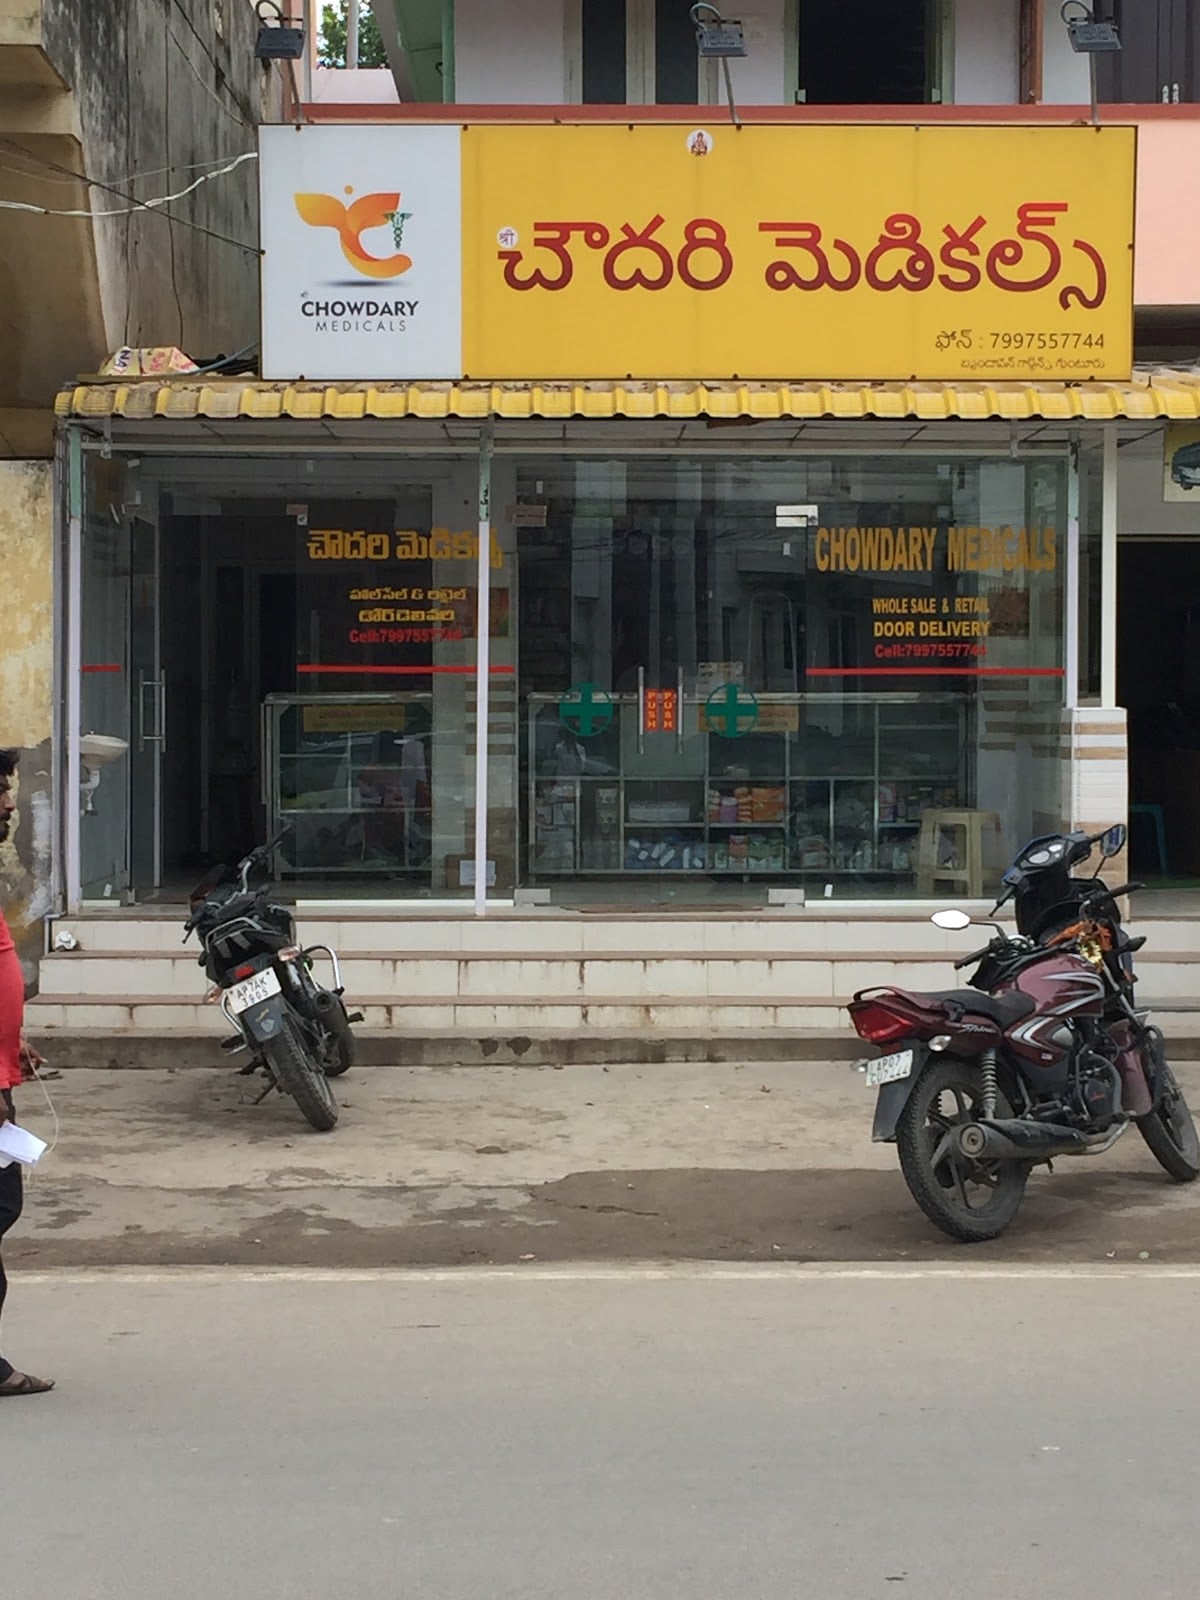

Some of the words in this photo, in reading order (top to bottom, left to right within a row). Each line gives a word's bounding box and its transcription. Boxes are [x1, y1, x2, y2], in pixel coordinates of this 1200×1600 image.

[497, 214, 734, 291] చౌదరి
[758, 203, 1107, 311] మెడికల్స్
[301, 300, 419, 317] CHOWDARY
[315, 320, 407, 332] MEDICALS
[990, 333, 1105, 349] 7997557744
[815, 527, 938, 571] CHOWDARY
[946, 527, 1057, 571] MEDICALS
[872, 598, 908, 614] WHOLE
[911, 598, 937, 614] SALE
[955, 598, 990, 614] RETAIL
[874, 621, 915, 637] DOOR
[919, 621, 991, 637] DELIVERY
